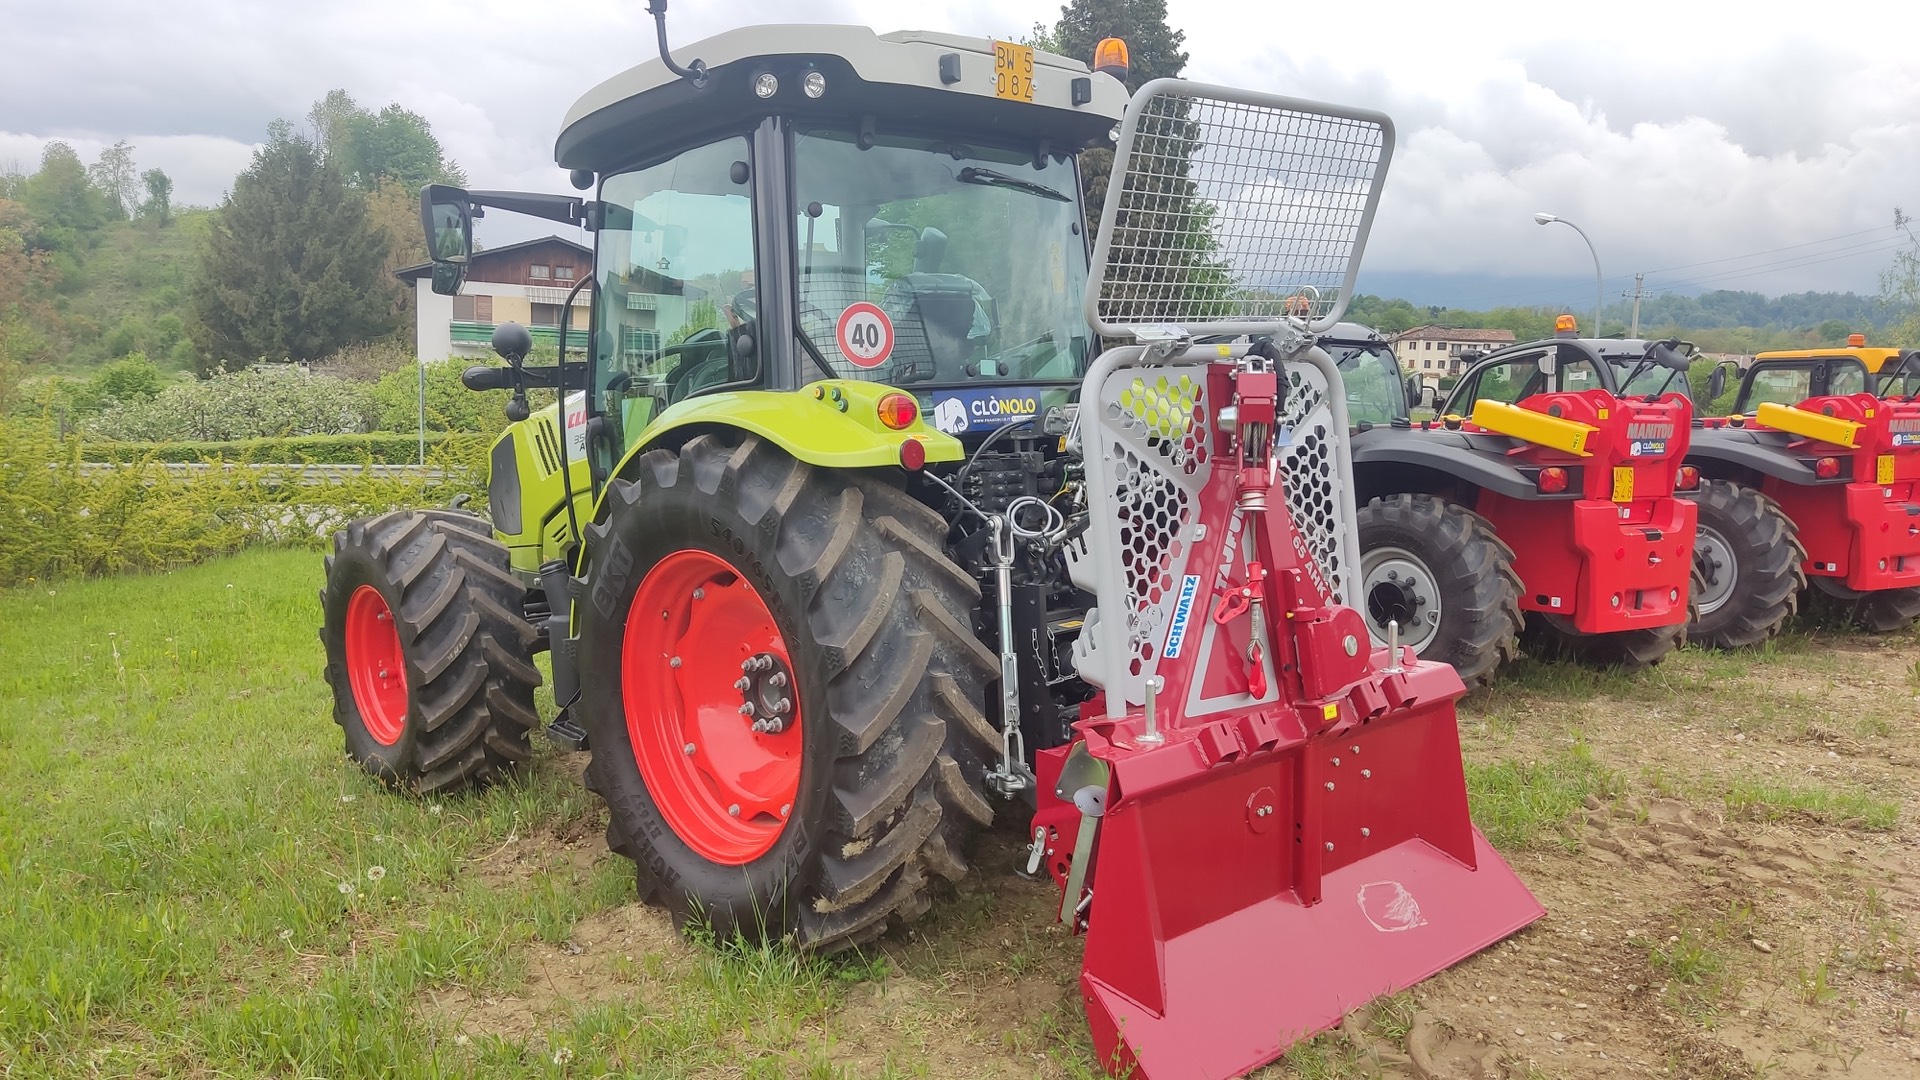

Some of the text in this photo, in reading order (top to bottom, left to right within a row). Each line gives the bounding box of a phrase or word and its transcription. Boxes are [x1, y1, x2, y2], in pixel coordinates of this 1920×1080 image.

[997, 47, 1032, 73] BW 5
[851, 323, 879, 348] 40
[971, 396, 1036, 416] CLÒNOLO
[1626, 422, 1674, 439] MANITOU
[1888, 419, 1920, 432] MANIT
[1292, 535, 1328, 599] 65 AHK
[1165, 576, 1197, 657] SCHWARZ
